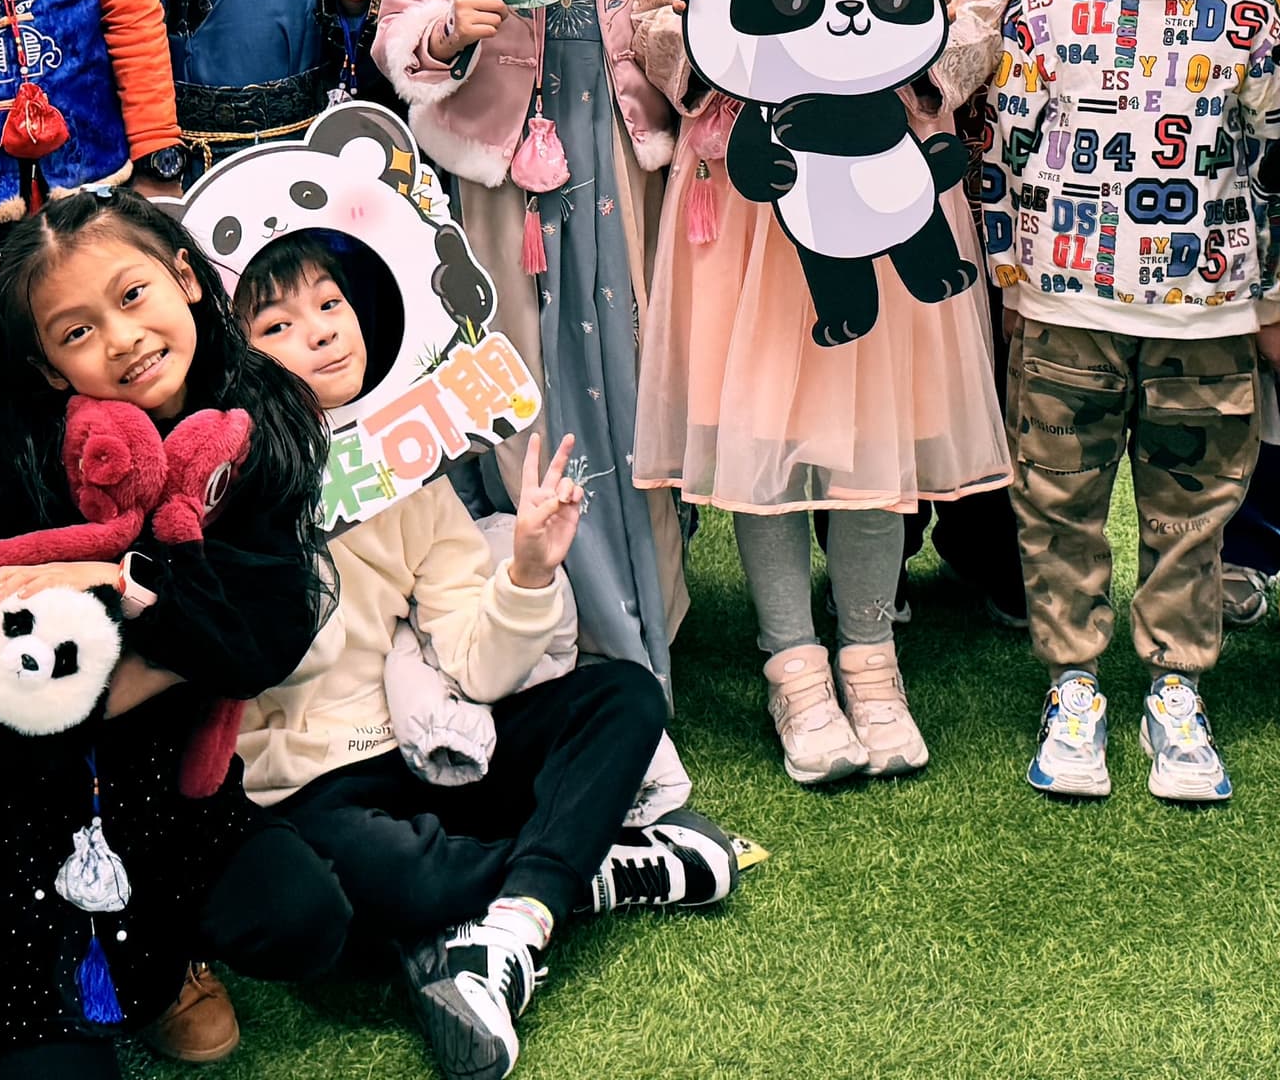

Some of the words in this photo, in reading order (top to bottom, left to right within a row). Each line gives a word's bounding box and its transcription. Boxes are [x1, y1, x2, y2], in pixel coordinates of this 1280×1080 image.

[1071, 0, 1115, 36] GL
[1162, 27, 1190, 47] 84
[1101, 70, 1130, 91] ES
[1212, 64, 1233, 80] 84
[1118, 95, 1140, 110] 84
[1101, 182, 1122, 197] 84
[1020, 212, 1040, 235] ES
[1051, 196, 1099, 238] DS
[1139, 236, 1170, 256] RY
[1227, 227, 1251, 249] ES
[1052, 233, 1094, 271] GL
[1138, 266, 1165, 285] 84
